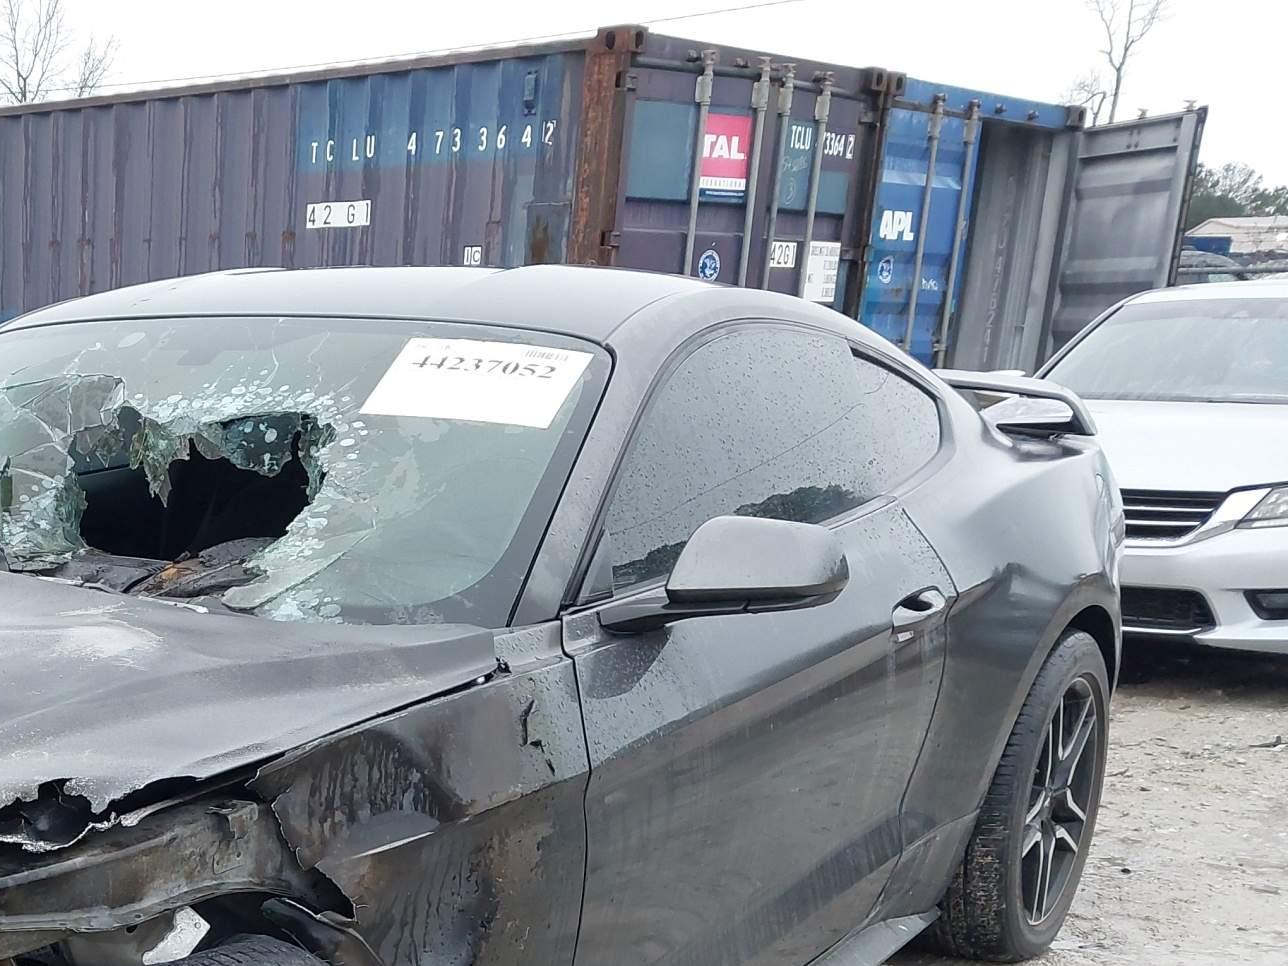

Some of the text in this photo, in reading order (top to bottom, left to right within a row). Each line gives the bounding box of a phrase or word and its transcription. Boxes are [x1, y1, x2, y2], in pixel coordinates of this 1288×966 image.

[703, 133, 746, 160] TAL
[790, 125, 812, 150] TCLU
[879, 210, 914, 241] APL
[412, 355, 557, 379] 44237052
